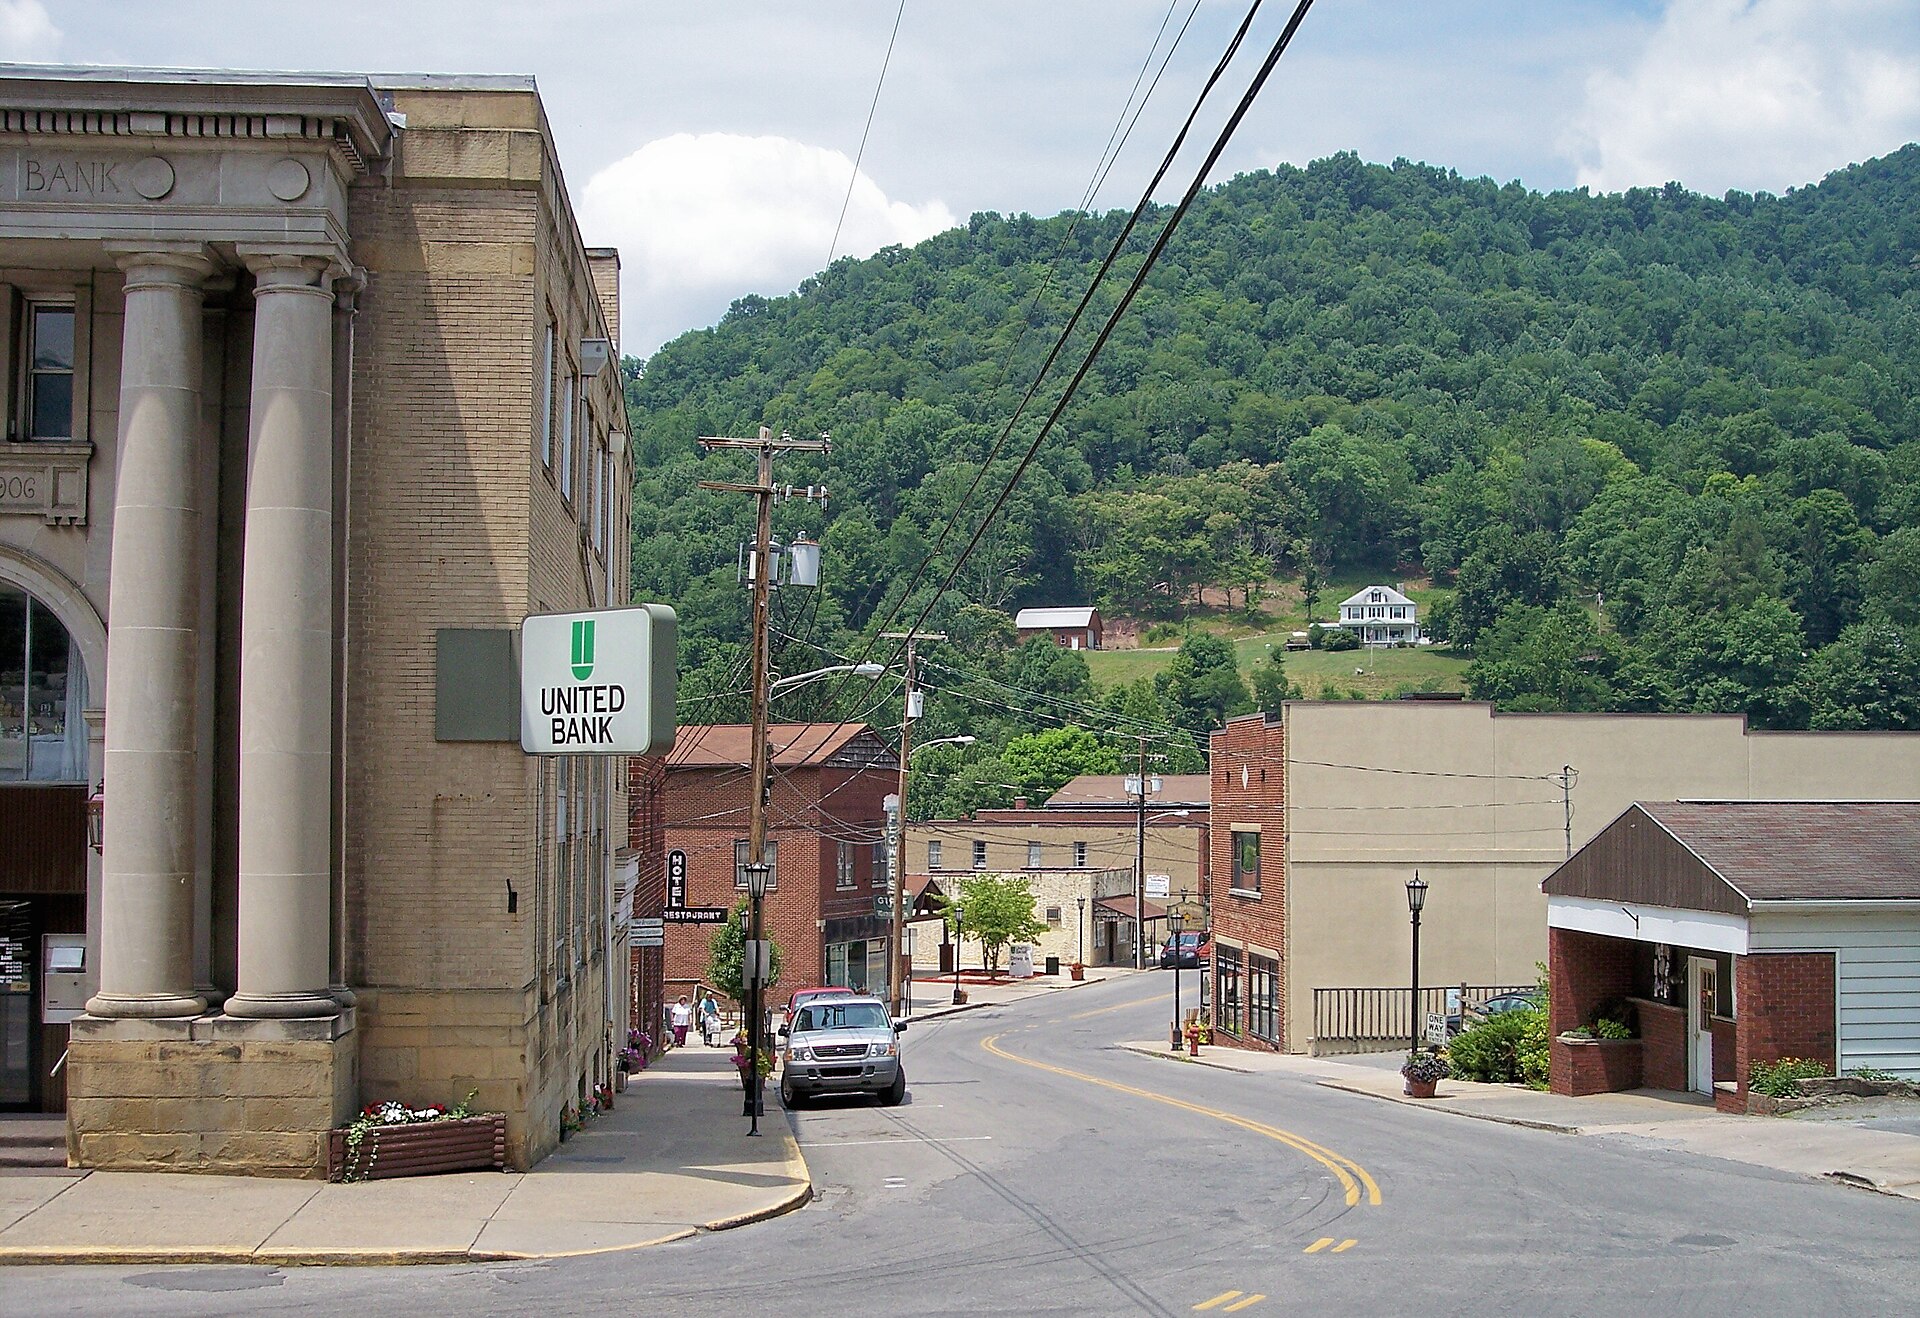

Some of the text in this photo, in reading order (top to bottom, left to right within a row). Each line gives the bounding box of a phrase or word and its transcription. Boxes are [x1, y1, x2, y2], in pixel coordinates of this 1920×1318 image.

[26, 160, 120, 197] BANK
[541, 685, 625, 716] UNITED
[551, 716, 614, 745] BANK
[672, 855, 683, 907] HOTEL
[663, 911, 721, 920] RESTAURANT
[1429, 1015, 1444, 1025] ONE
[1429, 1023, 1443, 1032] WAY
